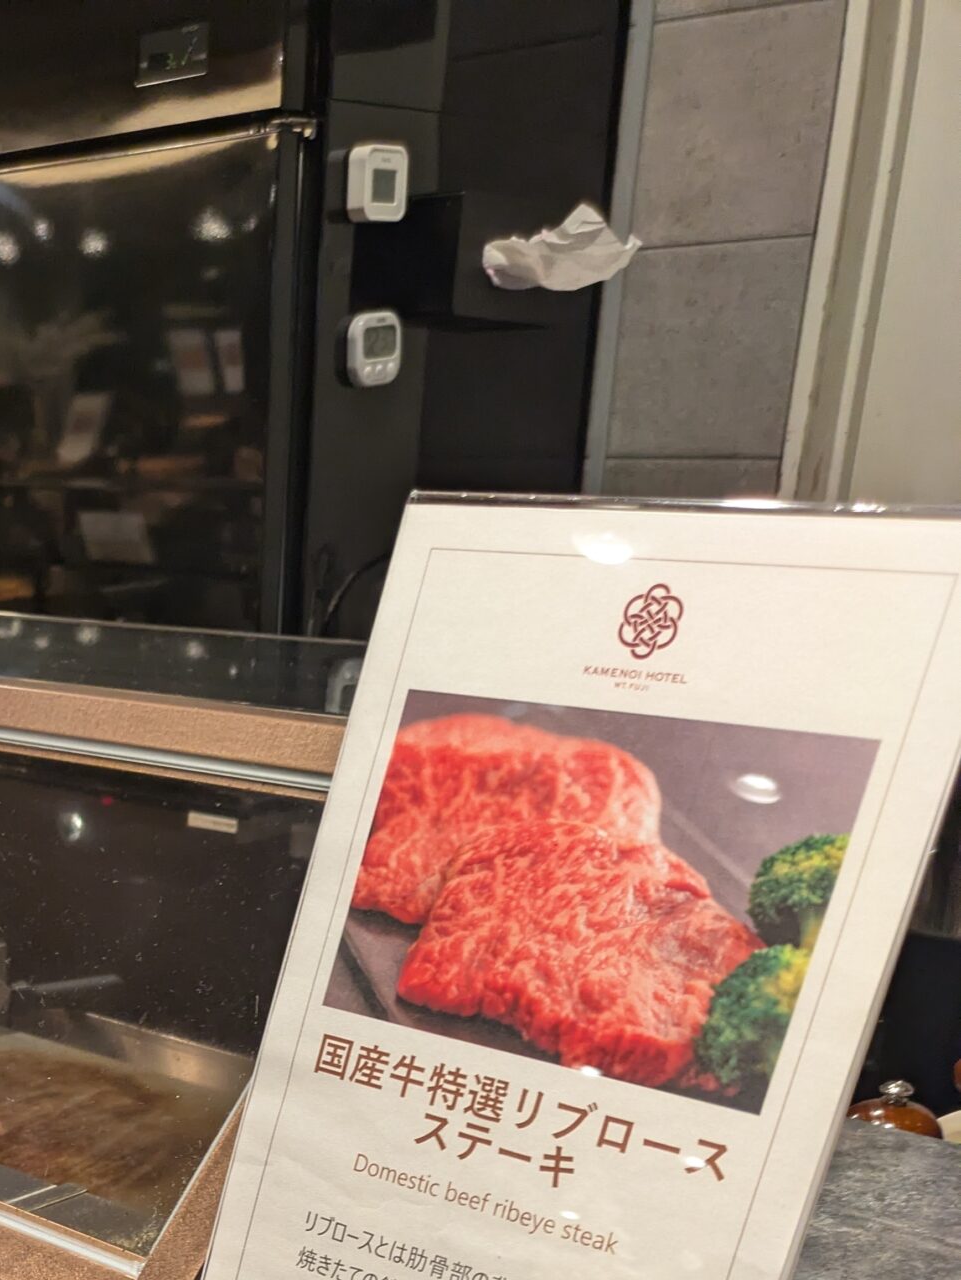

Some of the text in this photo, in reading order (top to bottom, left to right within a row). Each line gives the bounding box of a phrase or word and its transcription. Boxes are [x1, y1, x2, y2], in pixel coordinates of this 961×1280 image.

[583, 665, 688, 685] KAMENOI HOTEL
[312, 1033, 730, 1183] 国産牛特選リブロース
[414, 1112, 577, 1189] ステーキ
[352, 1153, 620, 1256] Domestic beef ribeye steak
